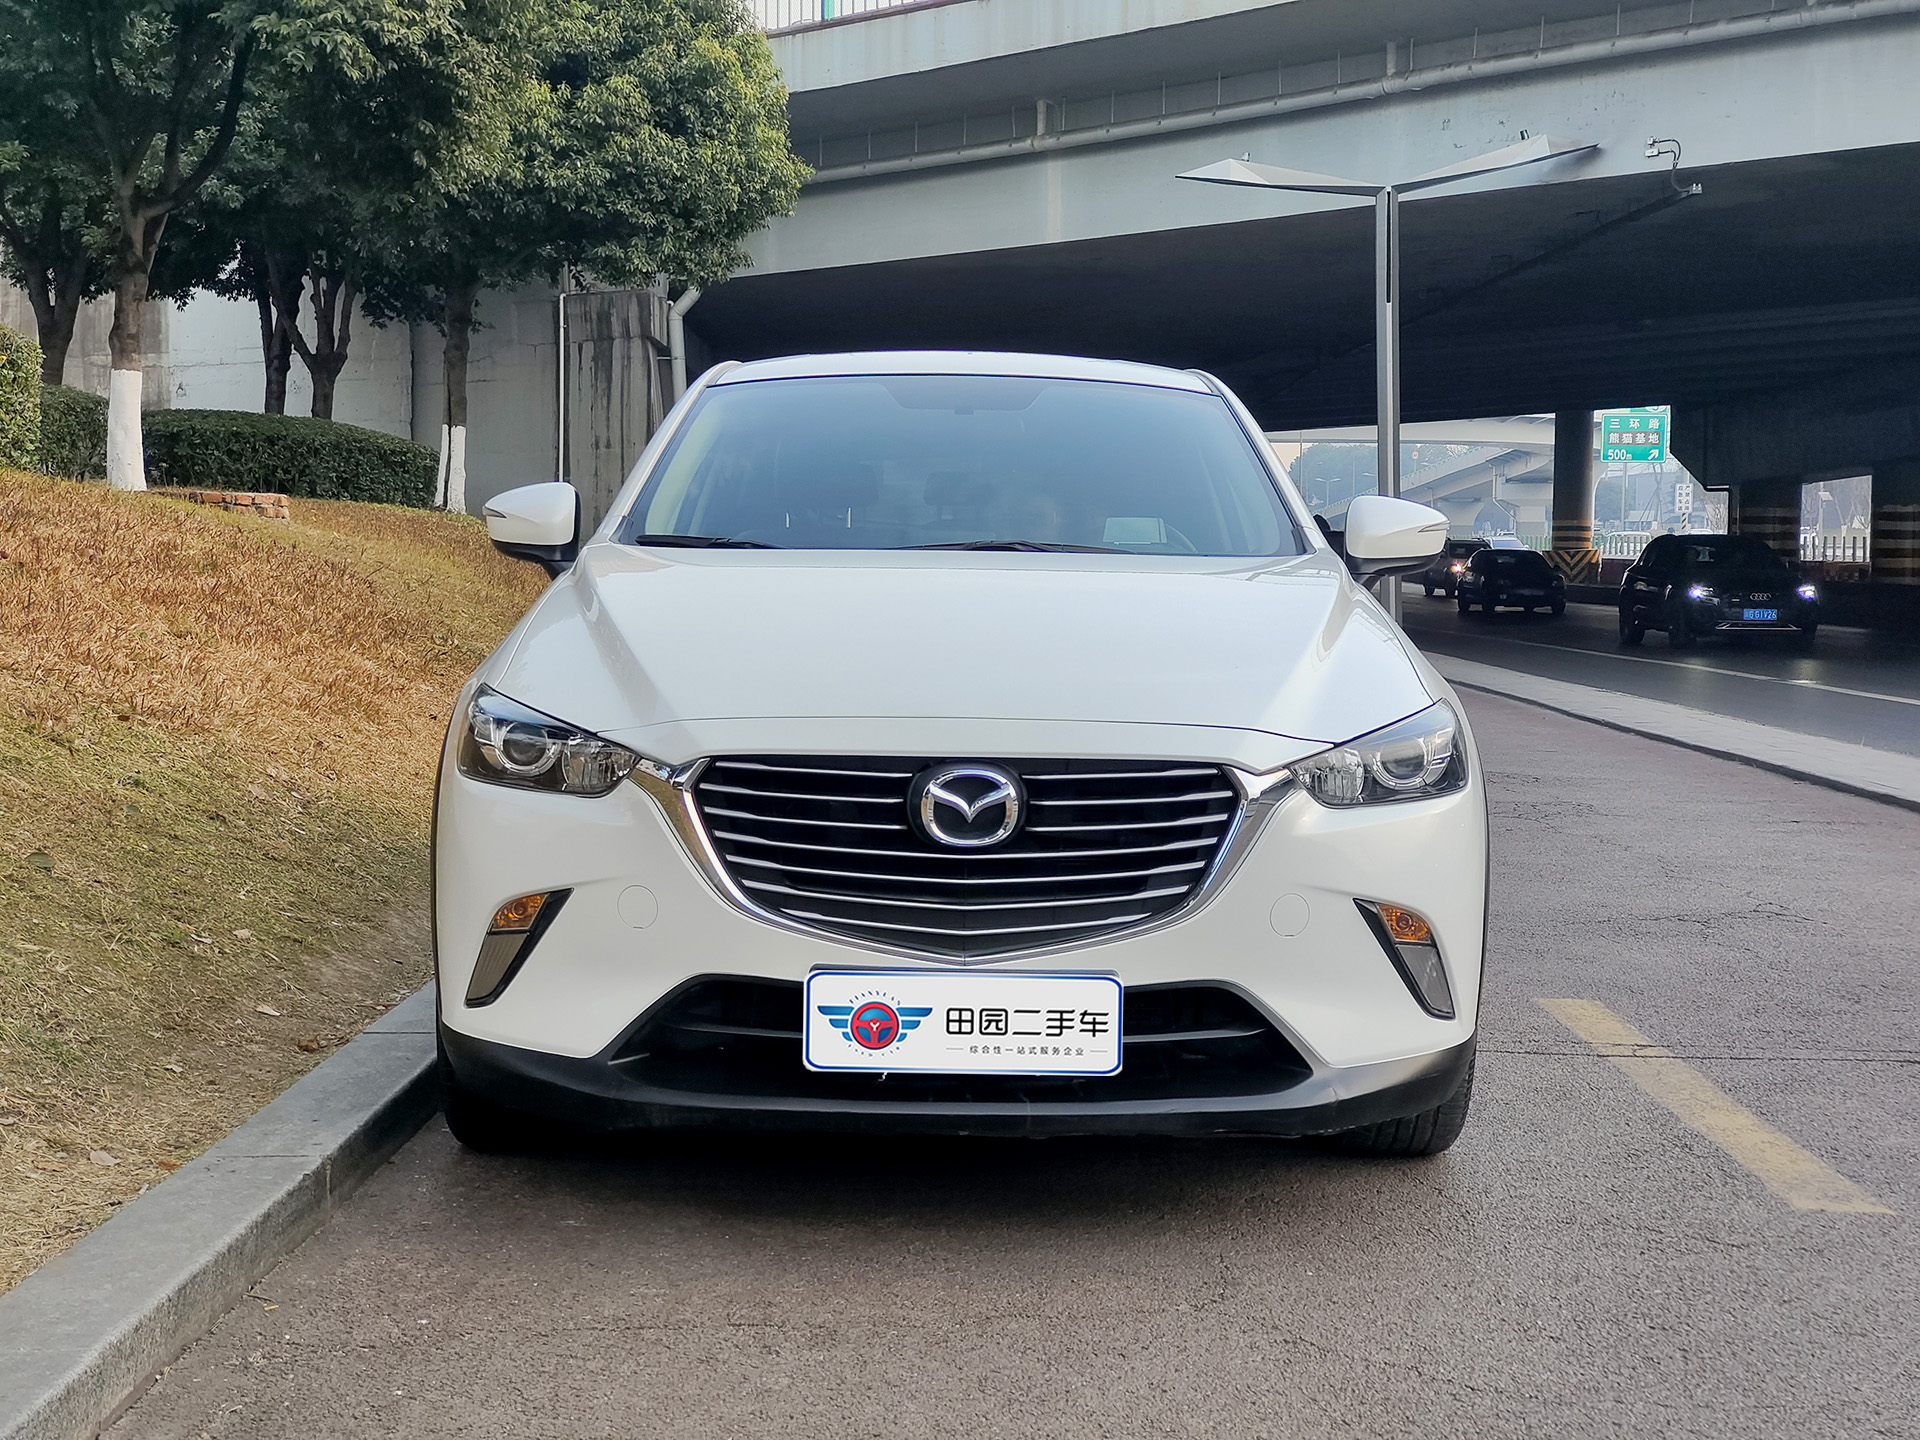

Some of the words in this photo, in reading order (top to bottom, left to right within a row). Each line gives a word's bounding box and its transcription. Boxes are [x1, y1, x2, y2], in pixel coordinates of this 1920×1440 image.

[1609, 418, 1660, 429] 三环路
[1608, 432, 1660, 444] 熊猫基地
[1607, 449, 1632, 460] 500m
[946, 1007, 1110, 1037] 田园二手车
[969, 1044, 1084, 1056] 综合性一站式服务企业
